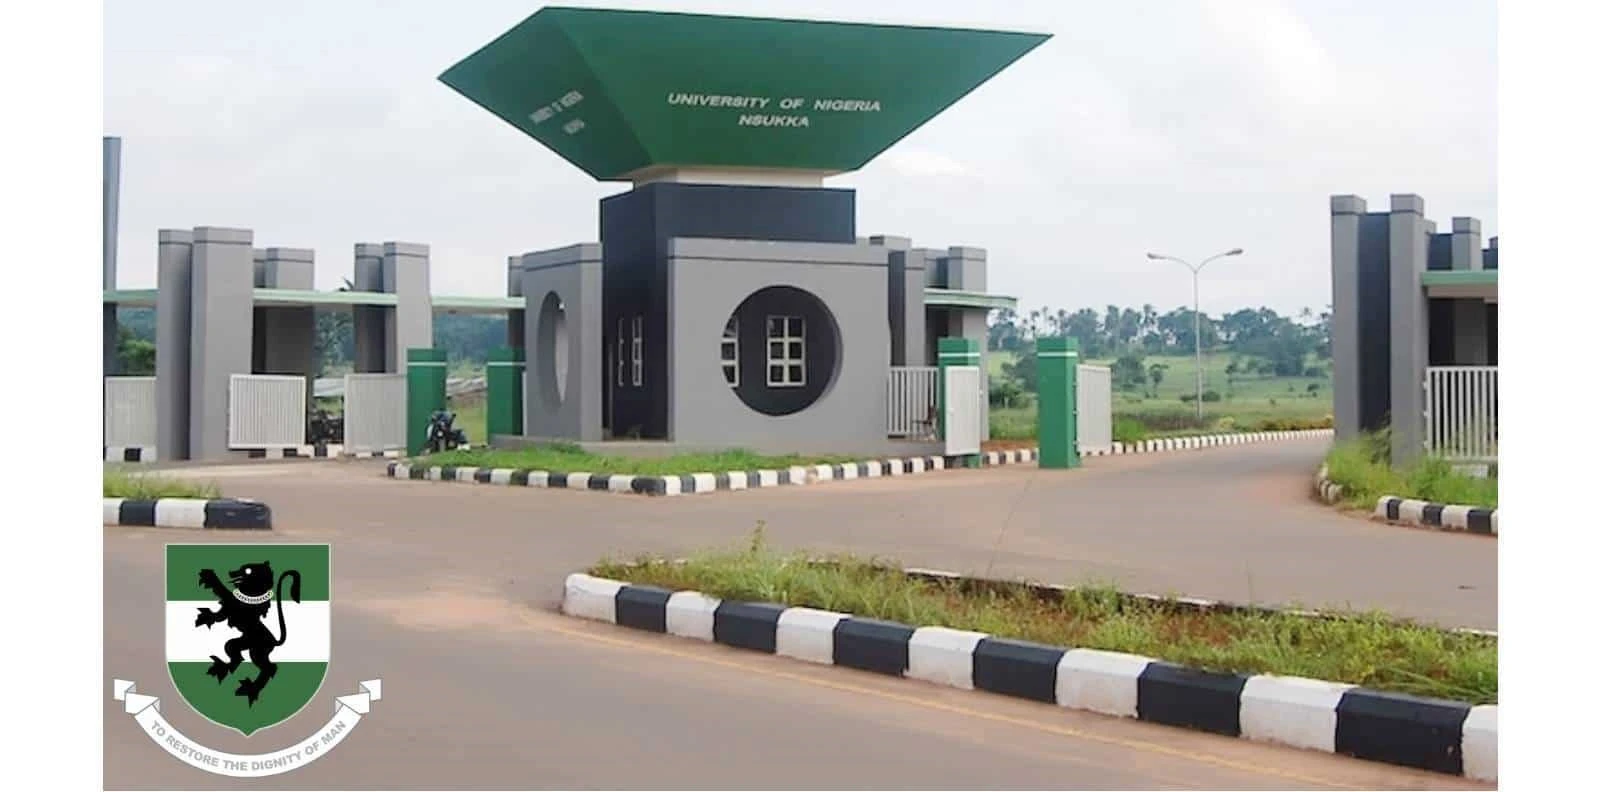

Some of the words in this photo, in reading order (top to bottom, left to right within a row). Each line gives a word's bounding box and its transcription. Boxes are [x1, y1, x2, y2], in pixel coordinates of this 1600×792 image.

[668, 93, 770, 108] UNIVERSITY
[780, 98, 804, 109] OF
[814, 99, 881, 111] NIGERIA
[738, 114, 809, 127] NSUKKA
